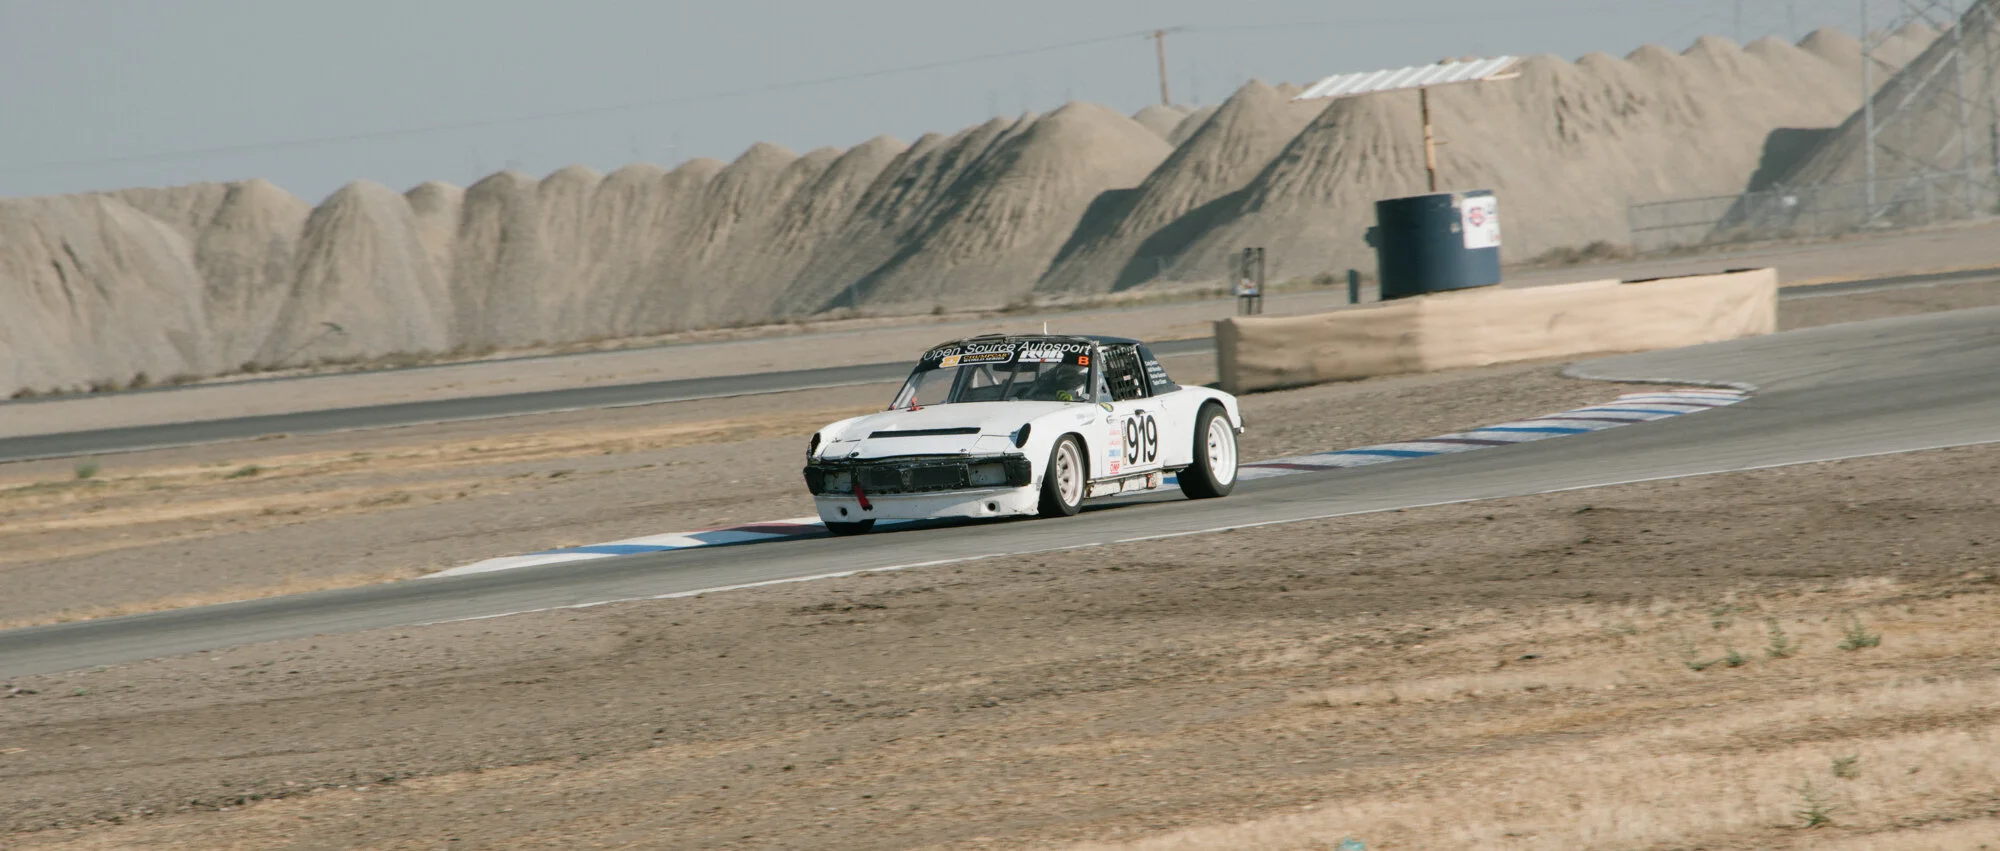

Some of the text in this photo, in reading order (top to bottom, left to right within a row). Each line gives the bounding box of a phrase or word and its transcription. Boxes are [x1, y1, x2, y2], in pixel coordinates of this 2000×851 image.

[924, 341, 1092, 361] Open Source Autosport
[1078, 356, 1089, 366] B
[1127, 414, 1158, 465] 919
